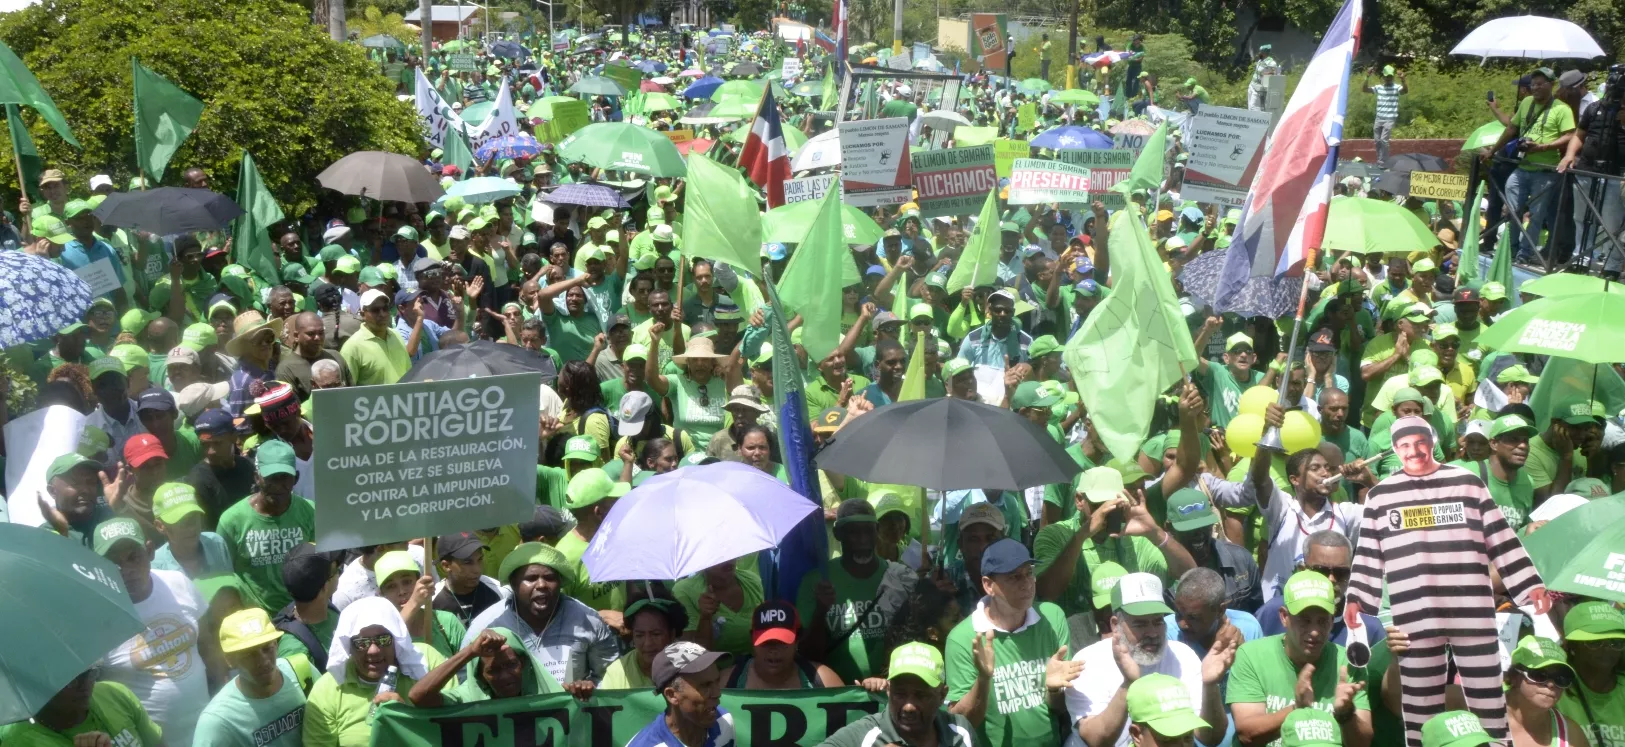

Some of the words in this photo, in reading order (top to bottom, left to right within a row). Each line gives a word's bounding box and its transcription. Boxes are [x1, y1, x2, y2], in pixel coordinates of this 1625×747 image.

[1122, 134, 1142, 148] NO
[1197, 130, 1226, 138] LUCHAMOS
[914, 156, 922, 168] EL
[924, 154, 946, 168] LIMON
[948, 152, 957, 165] DE
[959, 147, 991, 164] SAMANA
[1062, 152, 1070, 163] EL
[1072, 152, 1092, 163] LIMON
[1094, 152, 1101, 164] DE
[1102, 152, 1130, 164] SAMANA
[1015, 160, 1022, 168] EL
[1024, 160, 1046, 169] LIMON
[1048, 161, 1056, 170] DE
[1060, 162, 1087, 175] SAMANA
[916, 168, 996, 198] LUCHAMOS
[1011, 171, 1089, 191] PRESENTE
[1088, 171, 1112, 190] ANTA
[1424, 174, 1441, 183] MEJOR
[784, 181, 804, 195] PADRE
[807, 179, 820, 191] LAS
[172, 348, 181, 356] H
[354, 386, 505, 422] SANTIAGO
[345, 408, 514, 447] RODRIGUEZ
[327, 453, 371, 470] CUNA
[376, 452, 394, 465] DE
[400, 450, 416, 462] LA
[422, 437, 527, 460] RESTAURACIÓN,
[356, 470, 394, 485] OTRA
[398, 467, 422, 480] VEZ
[428, 465, 442, 477] SE
[447, 458, 502, 474] SUBLEVA
[347, 487, 408, 505] CONTRA
[413, 485, 429, 496] LA
[434, 474, 509, 494] IMPUNIDAD
[361, 510, 370, 521] Y
[375, 508, 392, 520] LA
[396, 492, 494, 516] CORRUPCIÓN.
[1404, 506, 1437, 517] MOVIMIENTO
[1439, 504, 1462, 514] POPULAR
[1405, 518, 1418, 527] LOS
[1419, 513, 1464, 526] PEREGRINOS
[100, 526, 136, 540] VERDE
[246, 527, 303, 542] #MARCHA
[761, 610, 786, 623] MPD
[1295, 720, 1333, 730] #MARCHA
[1295, 726, 1334, 741] VERDE
